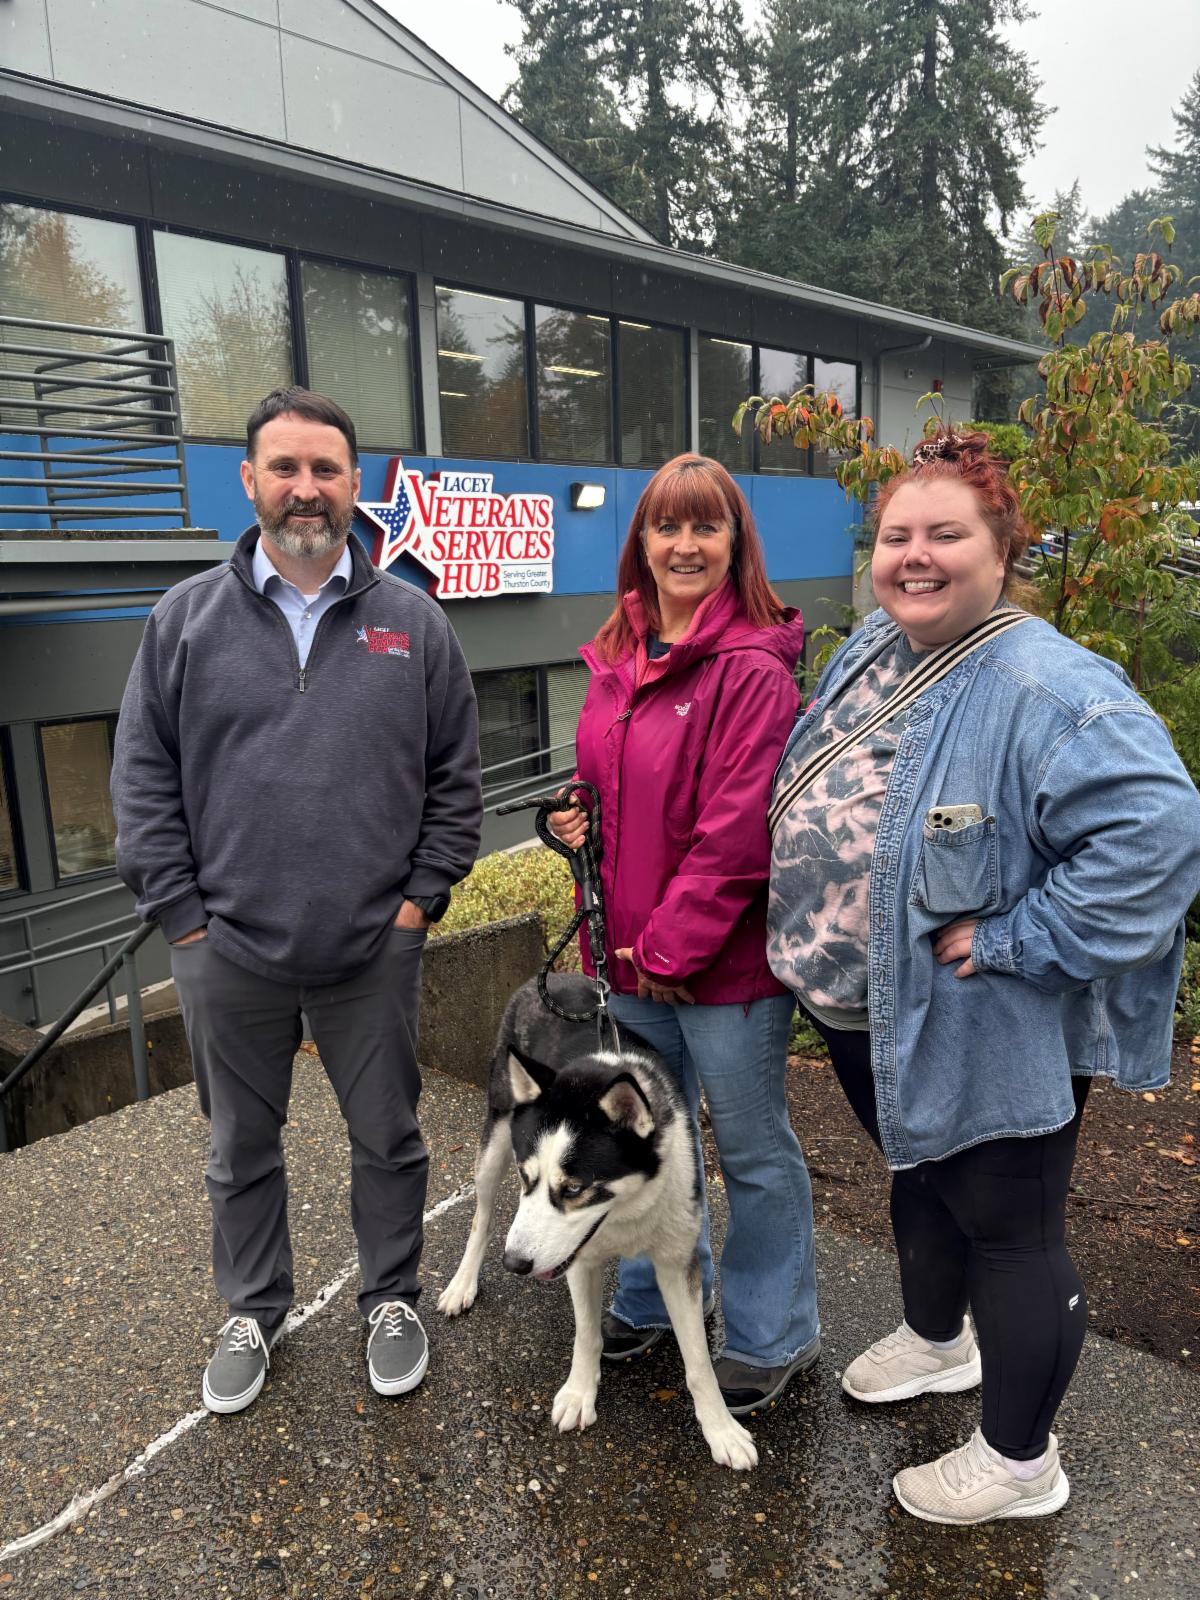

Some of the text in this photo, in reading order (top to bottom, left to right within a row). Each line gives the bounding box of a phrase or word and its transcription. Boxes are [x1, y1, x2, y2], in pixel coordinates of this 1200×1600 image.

[443, 476, 491, 493] LACEY
[408, 475, 550, 528] VETERANS
[430, 530, 551, 561] SERVICES
[441, 563, 500, 593] HUB
[503, 569, 547, 580] Serving Greater
[503, 579, 550, 589] Thurston County
